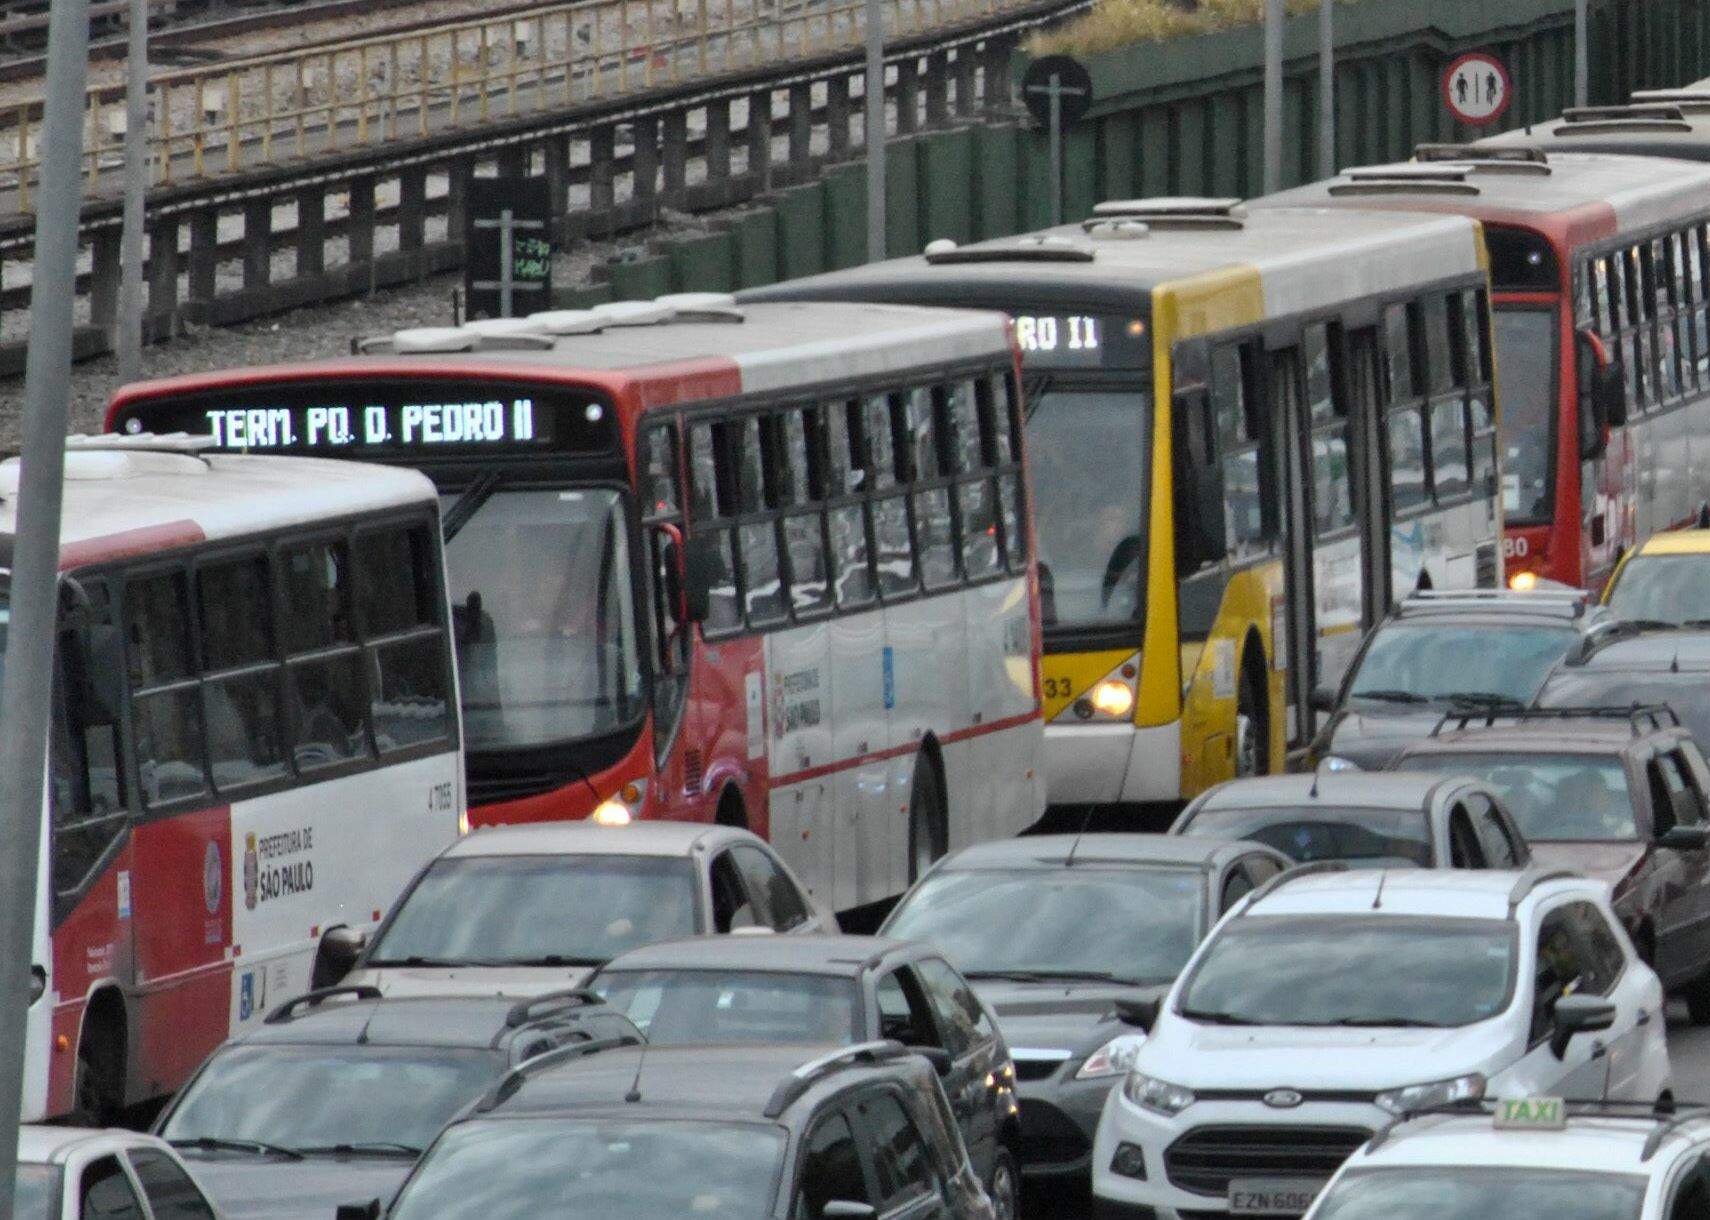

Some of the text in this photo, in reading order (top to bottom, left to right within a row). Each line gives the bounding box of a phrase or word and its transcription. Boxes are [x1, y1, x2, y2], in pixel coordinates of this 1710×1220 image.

[205, 399, 533, 448] TERM. PQ. D. PEDRO II
[258, 826, 313, 861] PREFEITURA DE
[259, 860, 313, 902] SÃO PAULO
[1503, 1099, 1560, 1121] TAXI
